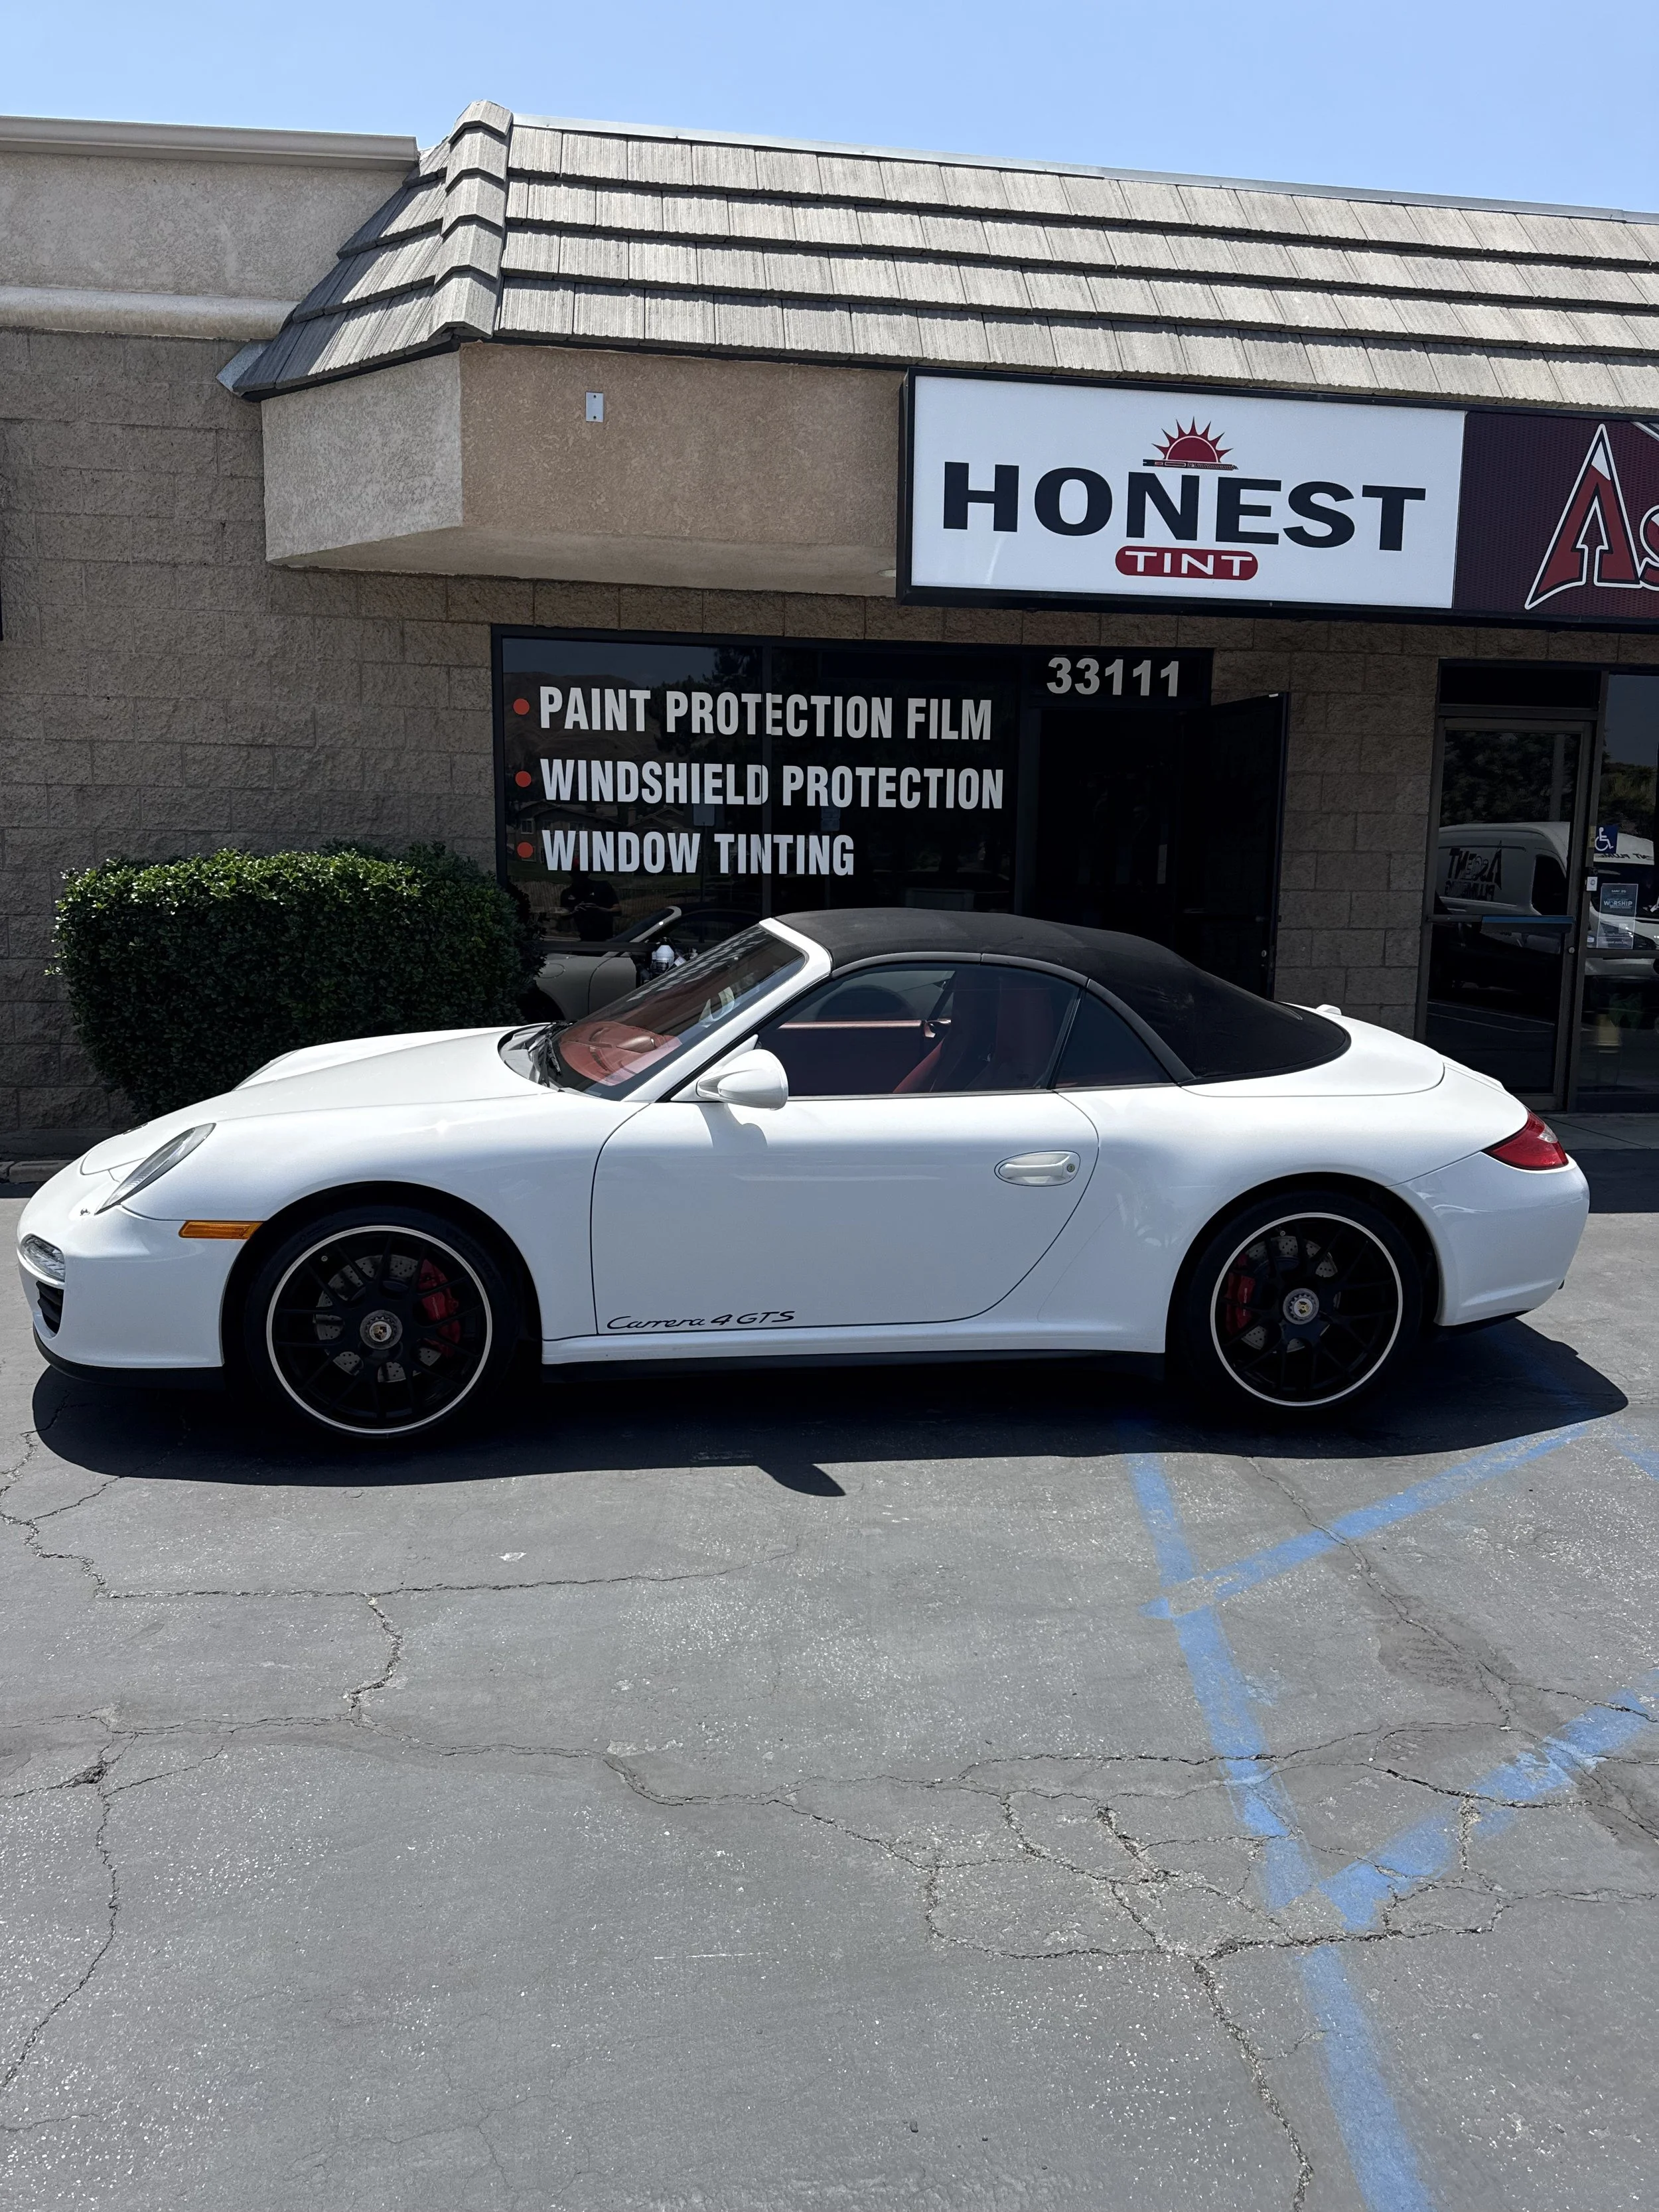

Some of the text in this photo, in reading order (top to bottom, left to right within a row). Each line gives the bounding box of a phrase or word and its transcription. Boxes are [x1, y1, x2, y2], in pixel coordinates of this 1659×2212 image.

[943, 461, 1426, 551] HONEST
[1125, 551, 1253, 577] TINT
[1046, 657, 1179, 697] 33111
[540, 686, 991, 741] PAINT PROTECTION FILM
[540, 759, 1003, 810] WINDSHIELD PROTECTION
[541, 830, 854, 876] WINDOW TINTING
[607, 1310, 796, 1329] Carrera 4 GTS
